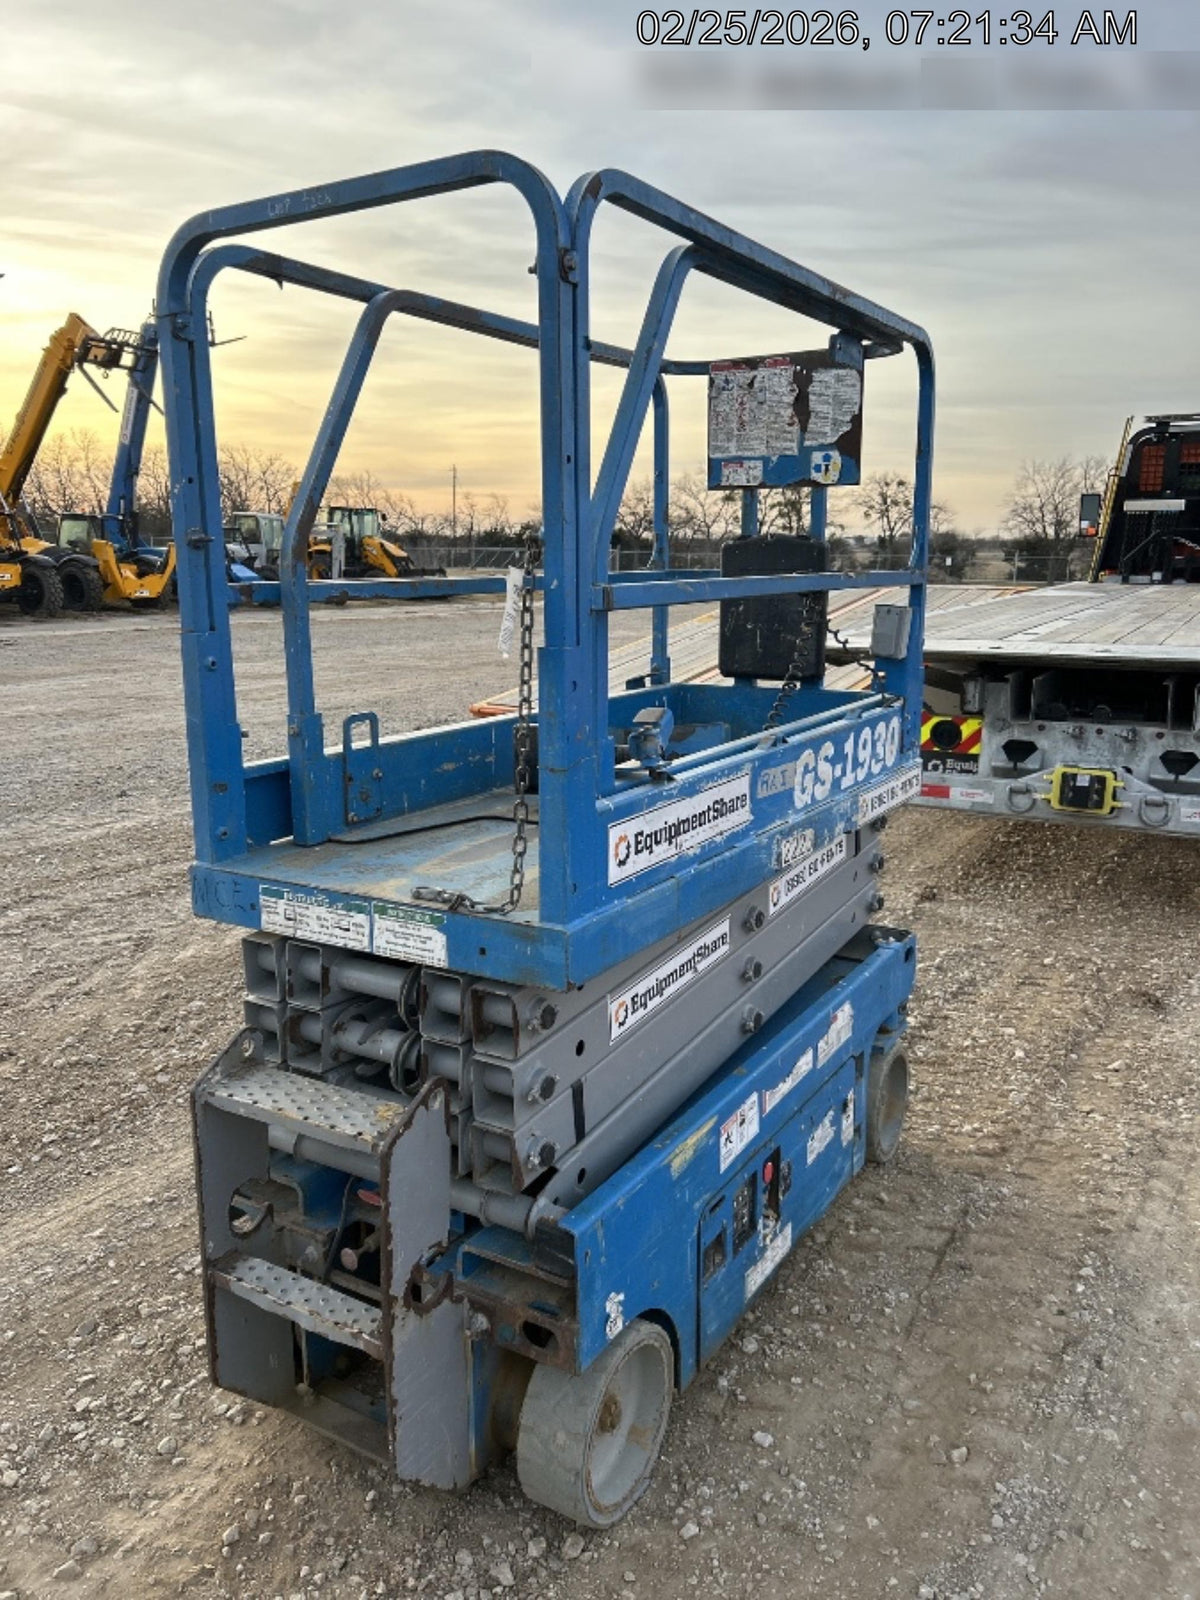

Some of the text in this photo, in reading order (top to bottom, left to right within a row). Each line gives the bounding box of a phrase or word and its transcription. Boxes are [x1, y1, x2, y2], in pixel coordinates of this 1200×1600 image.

[793, 716, 900, 810] GS-1930
[634, 793, 748, 856] EquipmentShare
[630, 932, 728, 1015] EquipmentShare
